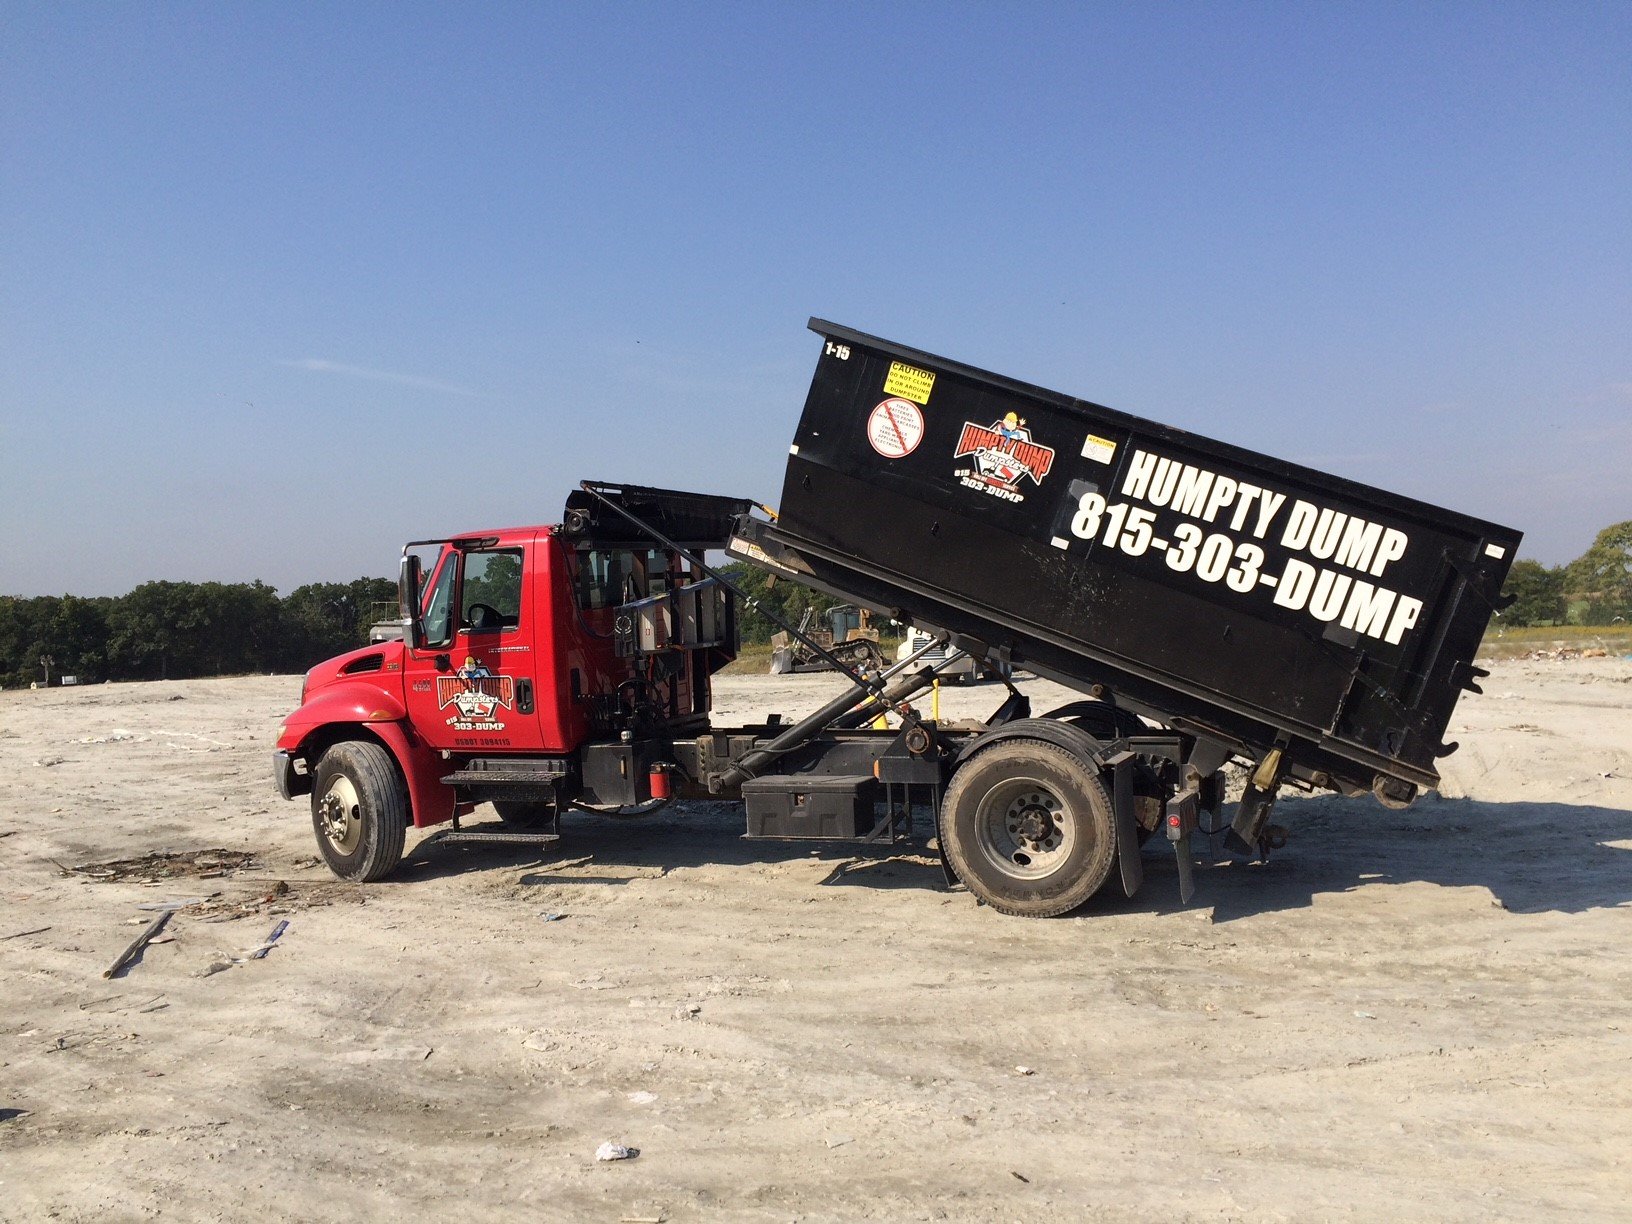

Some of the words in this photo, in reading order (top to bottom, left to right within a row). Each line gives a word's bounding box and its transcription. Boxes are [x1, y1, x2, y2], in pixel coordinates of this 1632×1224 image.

[825, 341, 851, 361] 1-15
[892, 363, 935, 381] CAUTION
[899, 374, 911, 382] NOT
[912, 378, 931, 388] CLIMB
[890, 386, 922, 400] DUMPSTER
[904, 383, 929, 395] AROUND
[958, 425, 1015, 455] HUMPTY
[1014, 440, 1053, 481] DUMP
[974, 447, 1029, 473] Dumpsters
[960, 478, 1024, 503] 303-DUMP
[1121, 449, 1288, 539] HUMPTY
[1281, 498, 1409, 578] DUMP
[1070, 491, 1424, 646] 815-303-DUMP
[454, 693, 499, 703] Dumpsters
[454, 722, 505, 730] 303-DUMP
